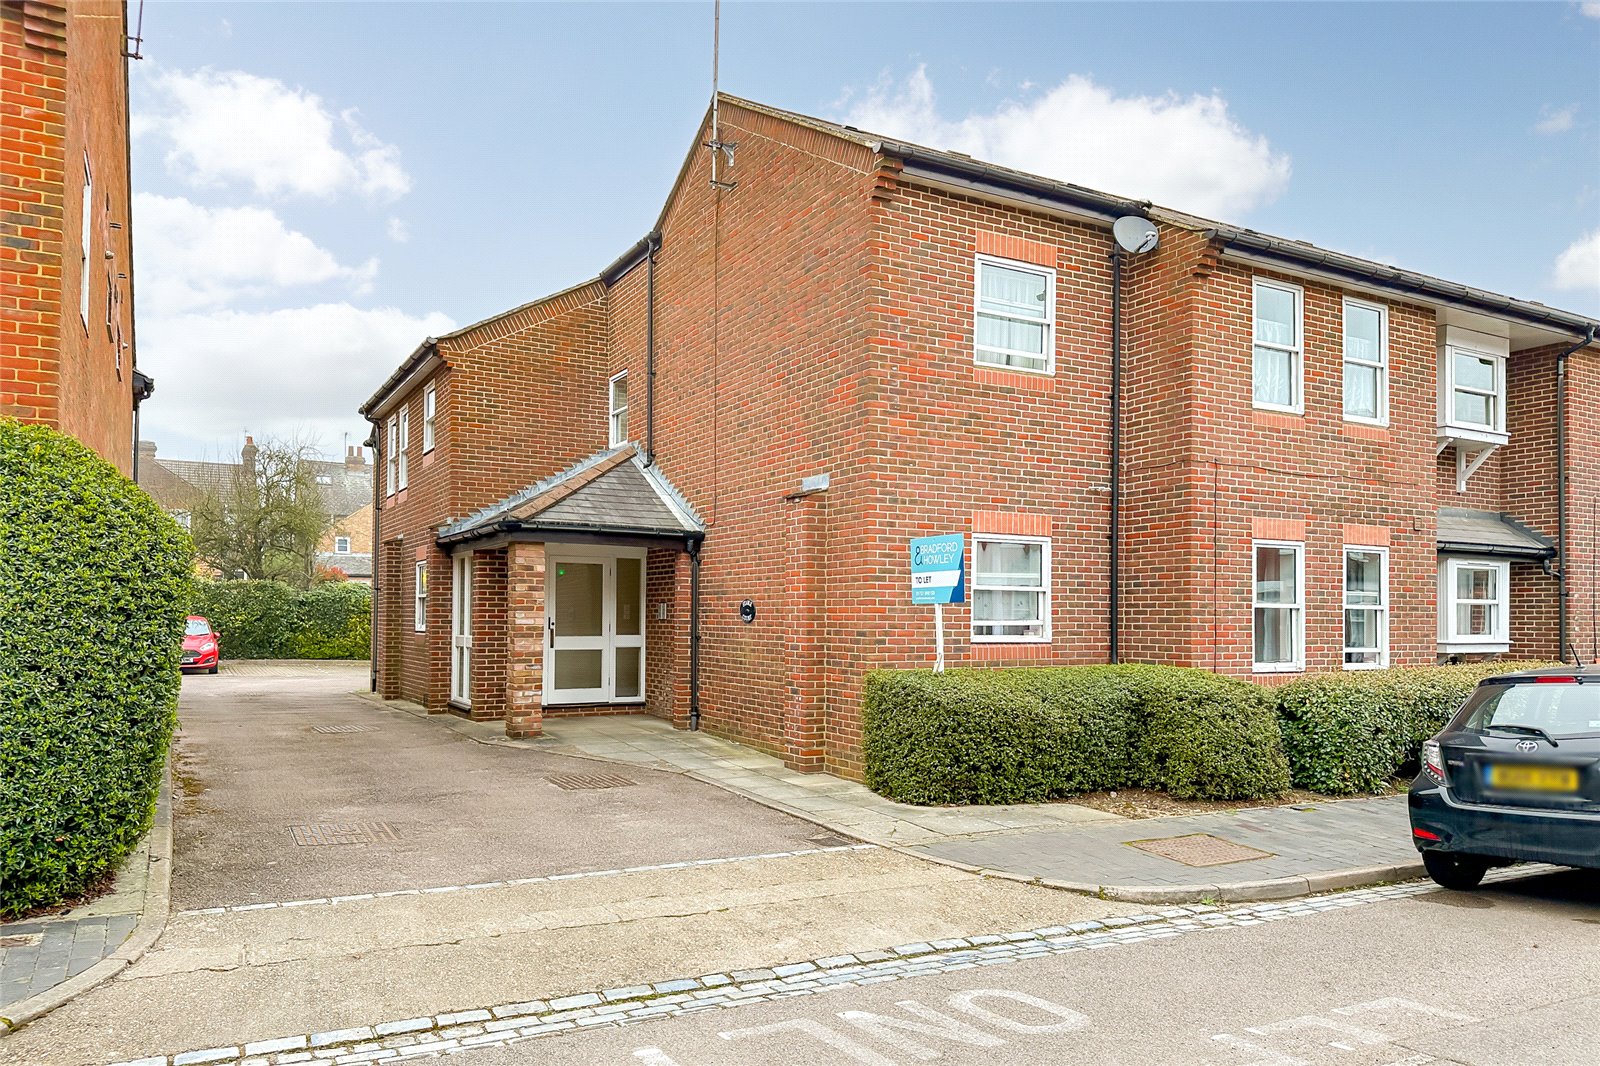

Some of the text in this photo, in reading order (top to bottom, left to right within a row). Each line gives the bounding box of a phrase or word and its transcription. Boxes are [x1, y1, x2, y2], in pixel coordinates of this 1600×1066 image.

[920, 542, 958, 554] BRADFORD
[923, 553, 955, 564] HOWLEY
[915, 576, 932, 584] TO LET
